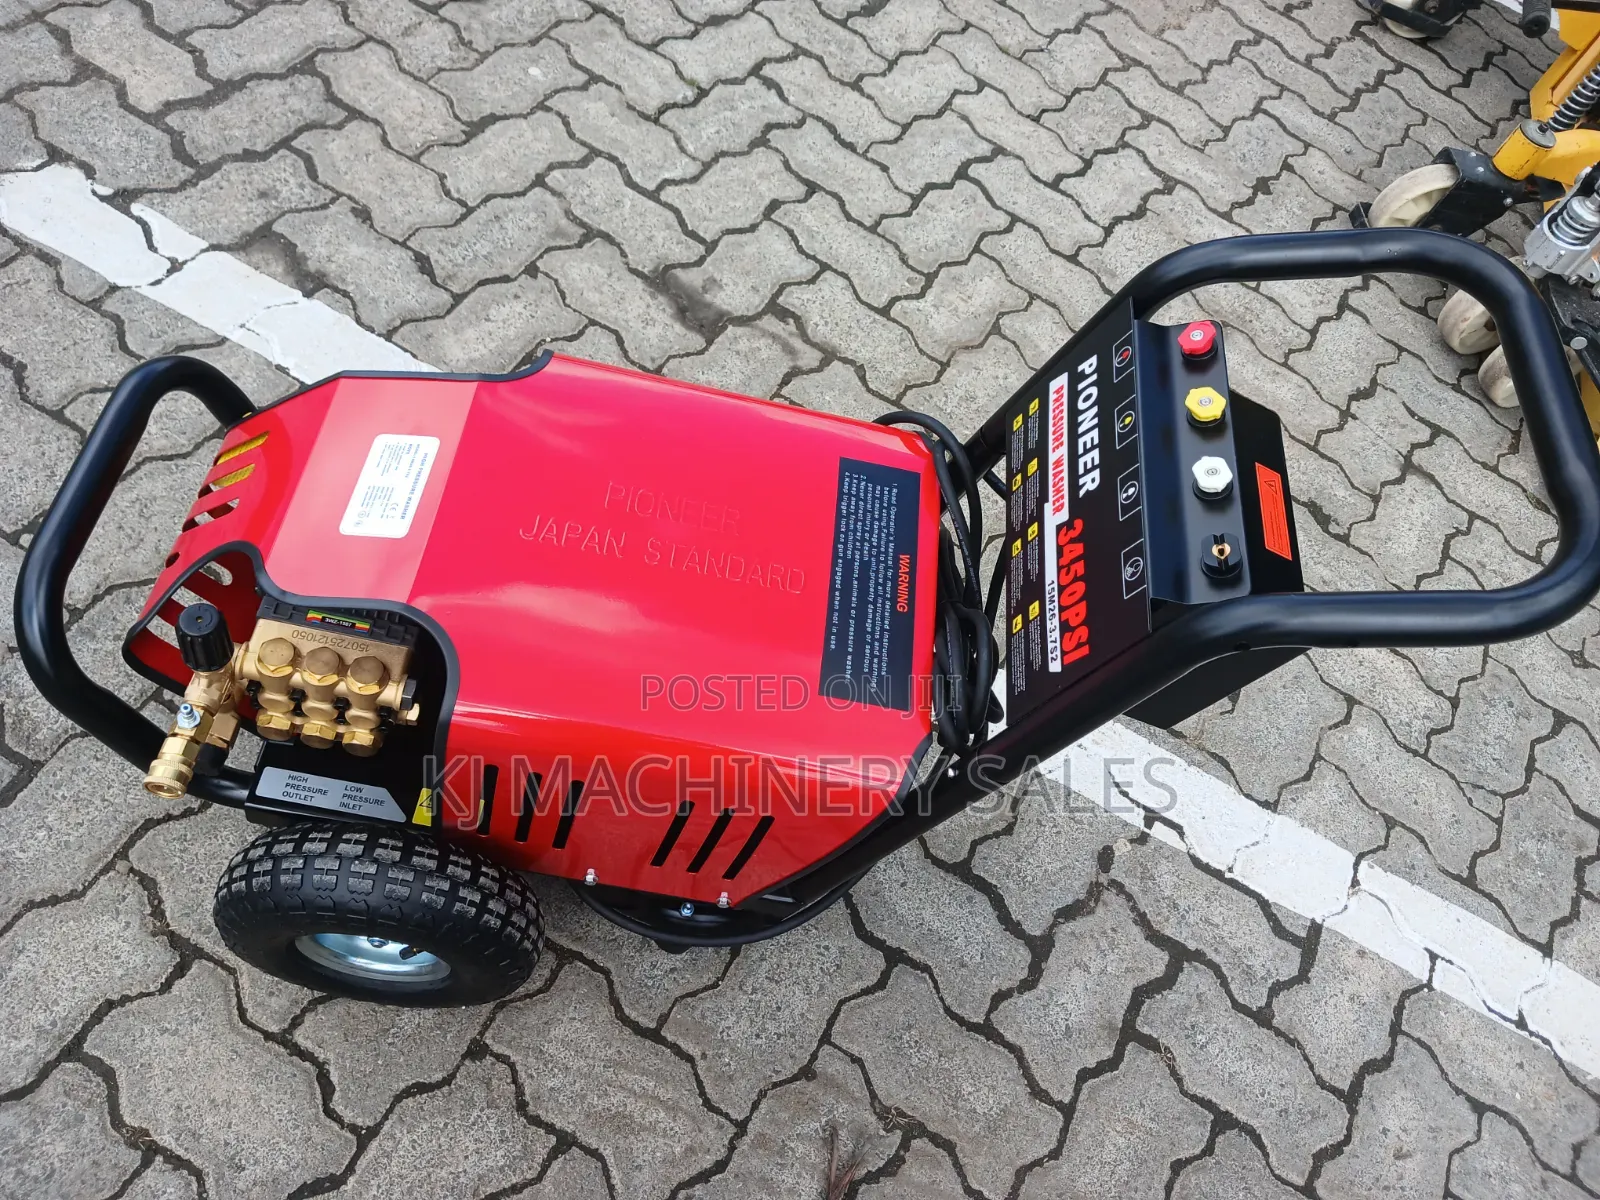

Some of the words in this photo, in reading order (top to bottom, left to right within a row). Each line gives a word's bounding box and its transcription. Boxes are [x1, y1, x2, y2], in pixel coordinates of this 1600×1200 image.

[1052, 384, 1064, 453] PRESSURE
[1077, 354, 1100, 498] PIONEER
[1052, 454, 1064, 516] WASHER
[604, 480, 740, 536] PIONEER
[840, 534, 845, 542] on
[519, 515, 626, 558] JAPAN
[644, 537, 806, 594] STANDARD
[835, 559, 844, 588] engaged
[897, 555, 910, 612] WARNING
[1058, 518, 1090, 665] 3450PSI
[866, 604, 875, 631] damage
[875, 597, 883, 638] instructions
[884, 601, 892, 629] detailed
[1048, 580, 1058, 663] 15M26-3.7S2
[291, 630, 370, 652] 150725121050
[847, 619, 855, 652] pressure
[864, 645, 872, 672] serious
[881, 632, 890, 675] instructions
[285, 782, 329, 796] PRESSURE
[287, 773, 309, 783] HIGH
[344, 784, 364, 793] LOW
[282, 790, 315, 802] OUTLET
[339, 801, 363, 811] INLET
[342, 793, 386, 806] PRESSURE
